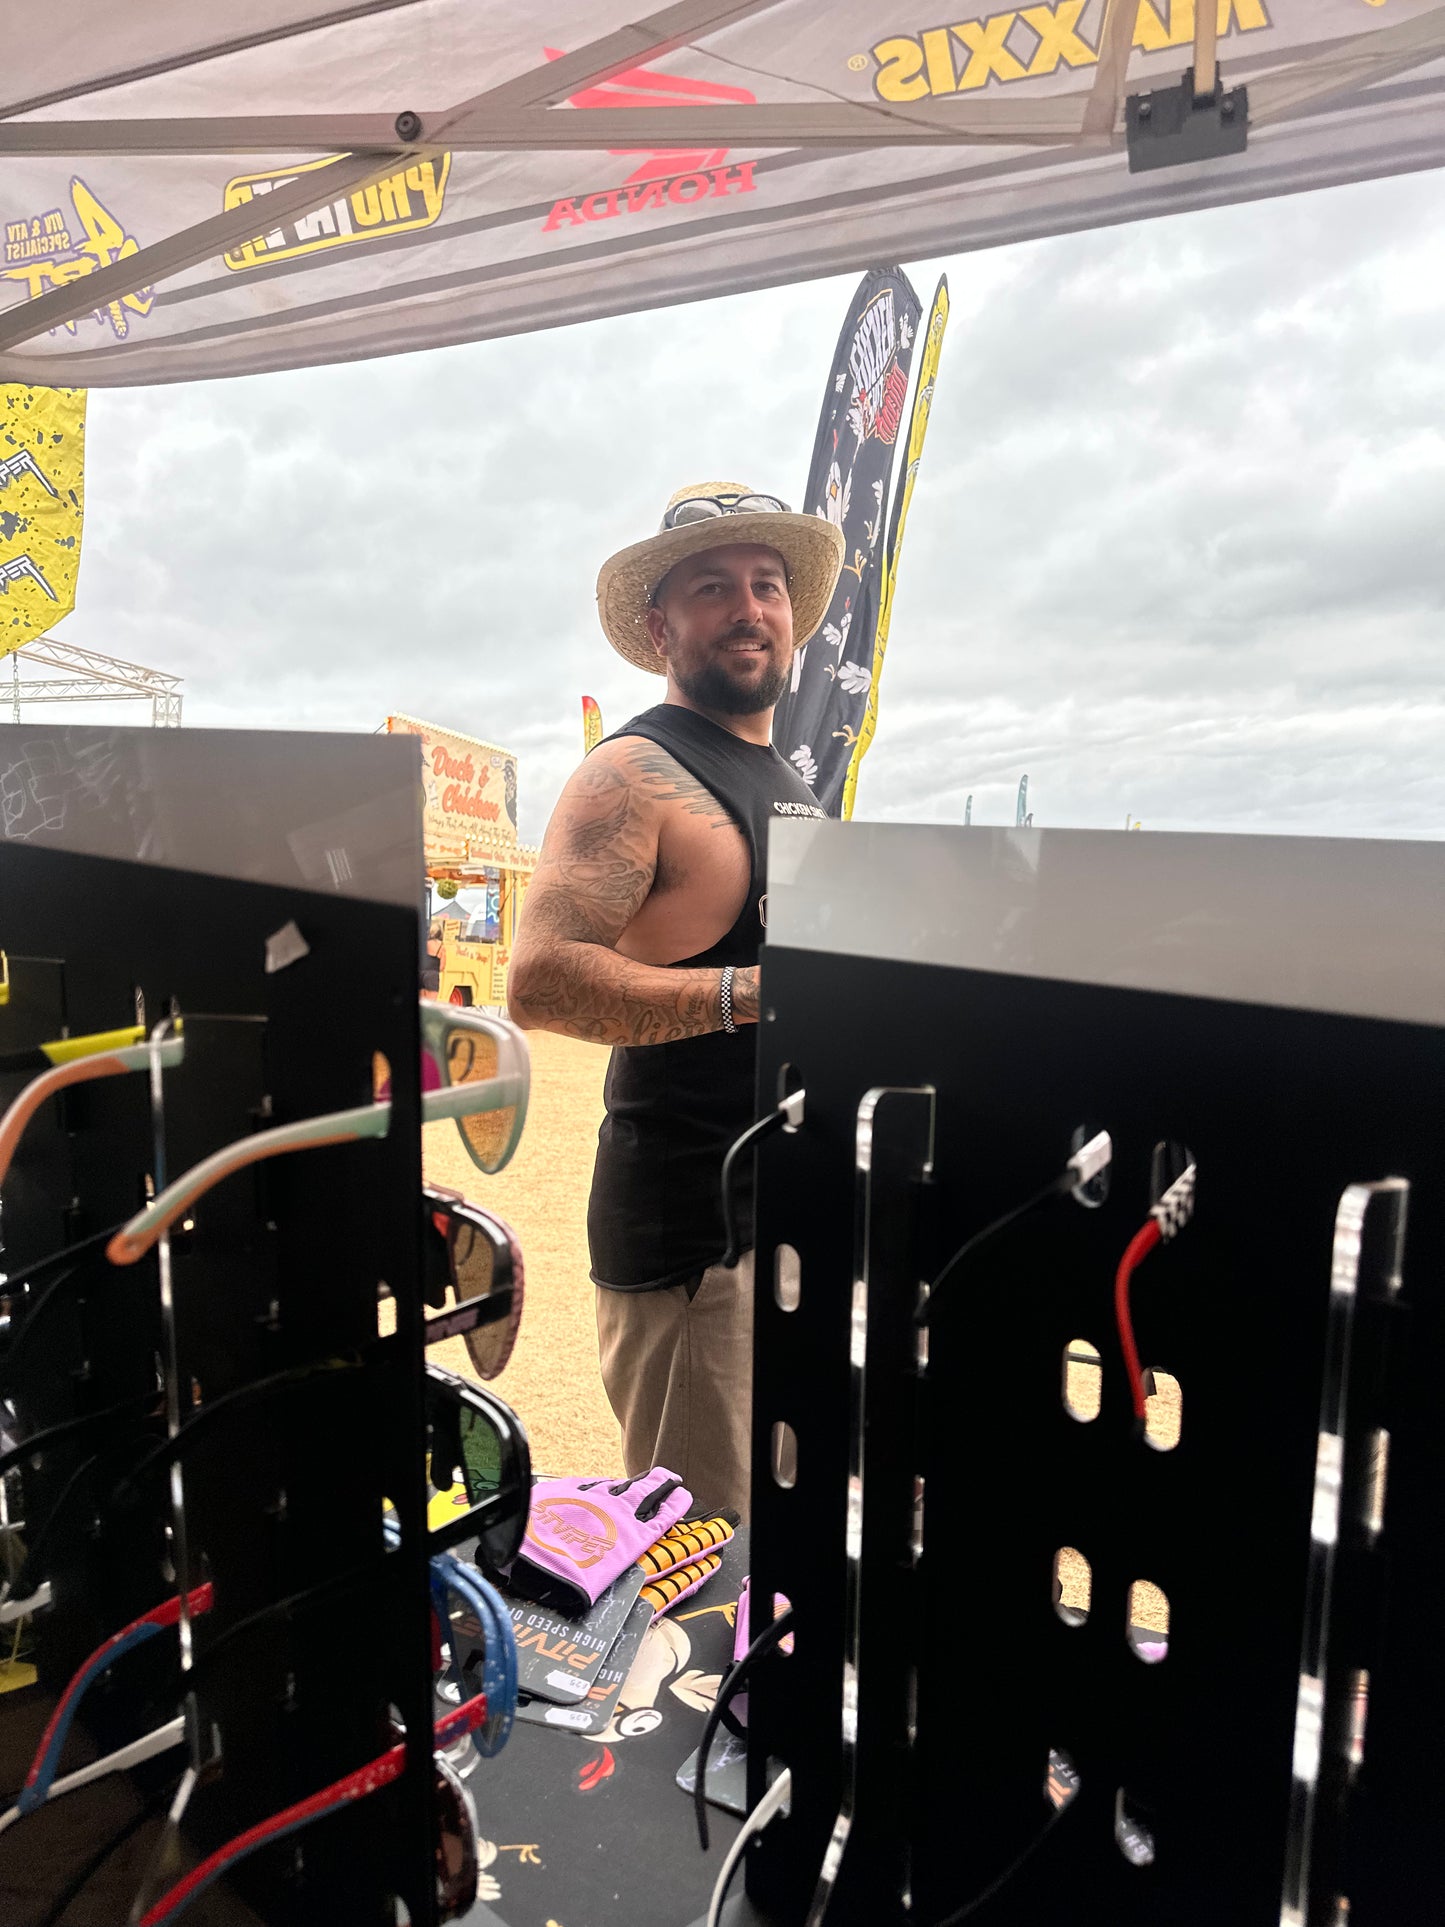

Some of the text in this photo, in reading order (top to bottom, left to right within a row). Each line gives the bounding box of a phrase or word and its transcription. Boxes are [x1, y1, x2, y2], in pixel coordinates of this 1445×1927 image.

[431, 746, 475, 784] Duck
[442, 783, 501, 823] Chicken
[773, 801, 813, 816] CHICKEN
[527, 1614, 570, 1638] SPEED
[572, 1630, 607, 1652] HIGH
